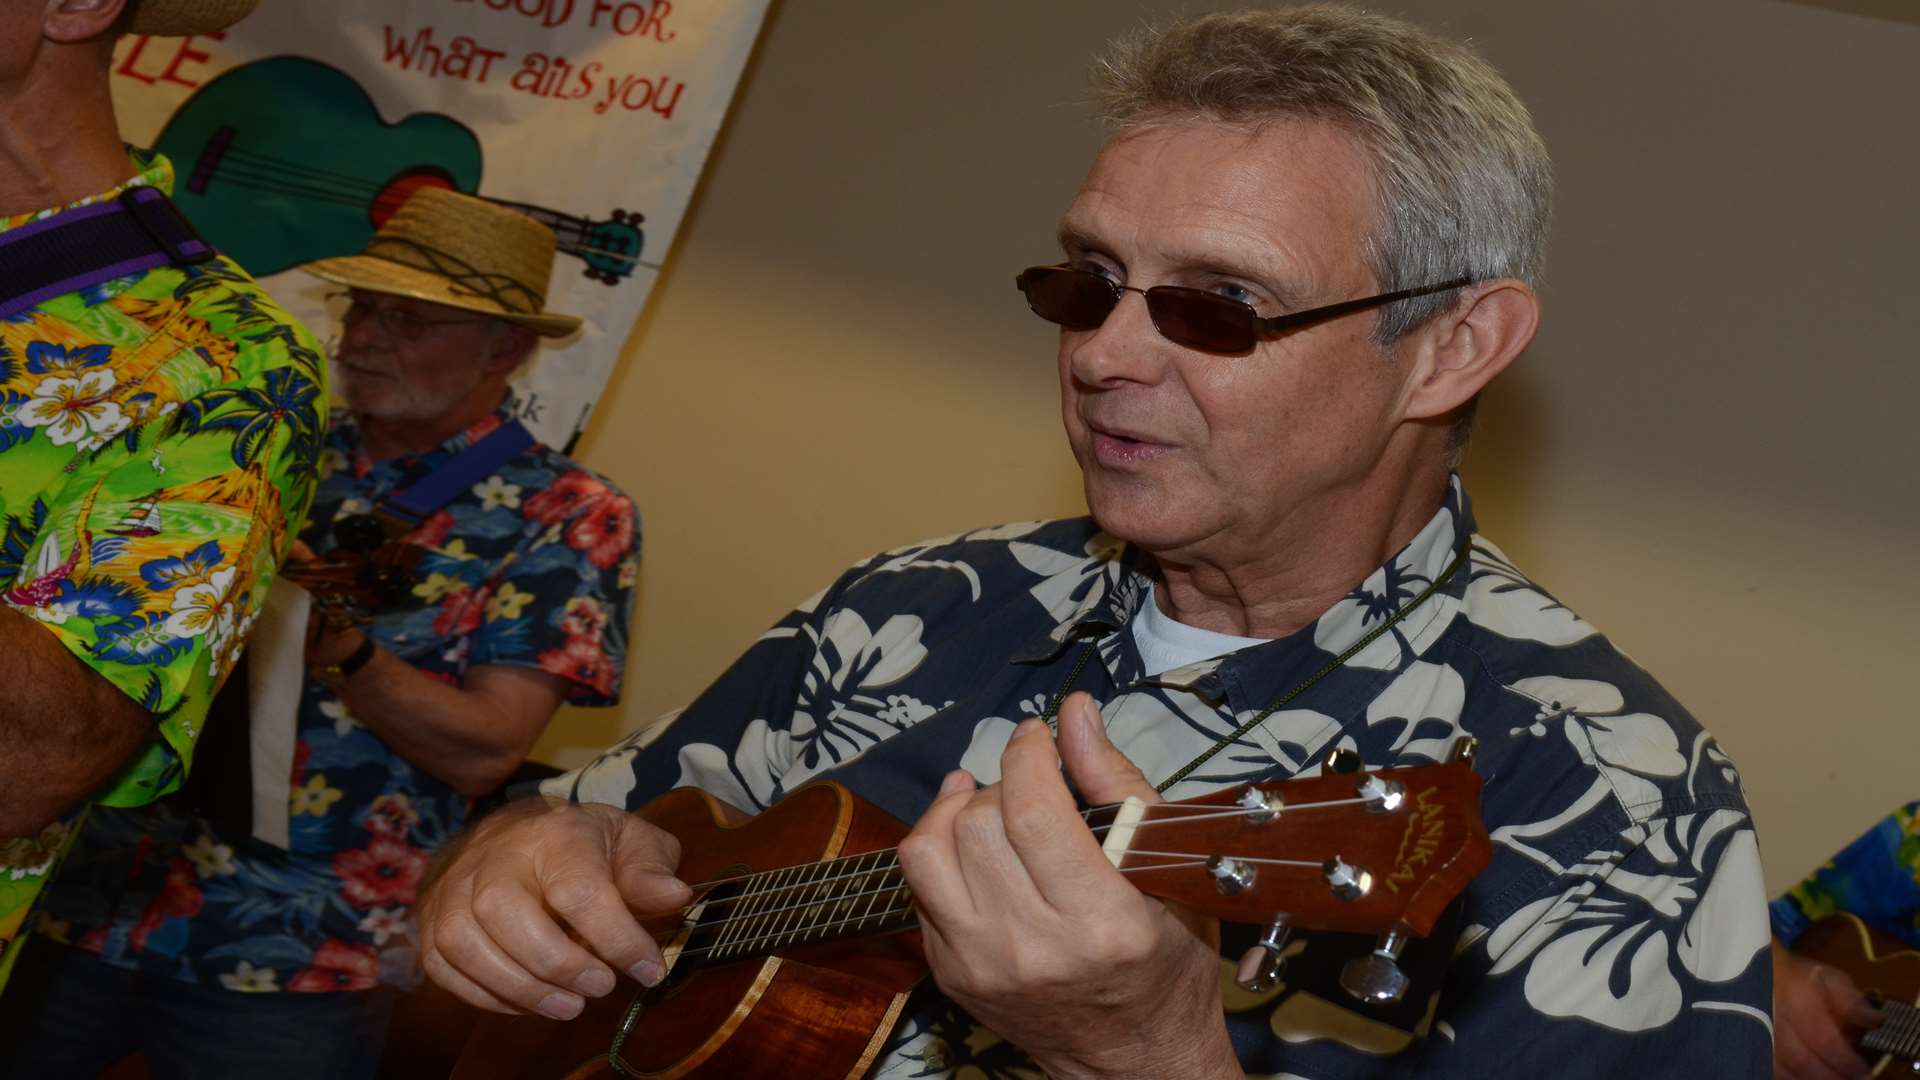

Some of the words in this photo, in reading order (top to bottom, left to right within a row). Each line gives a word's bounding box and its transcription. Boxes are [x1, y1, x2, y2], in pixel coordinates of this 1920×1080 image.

[589, 0, 676, 42] FOR
[112, 32, 226, 89] LE
[1385, 785, 1445, 894] LANIKAI
